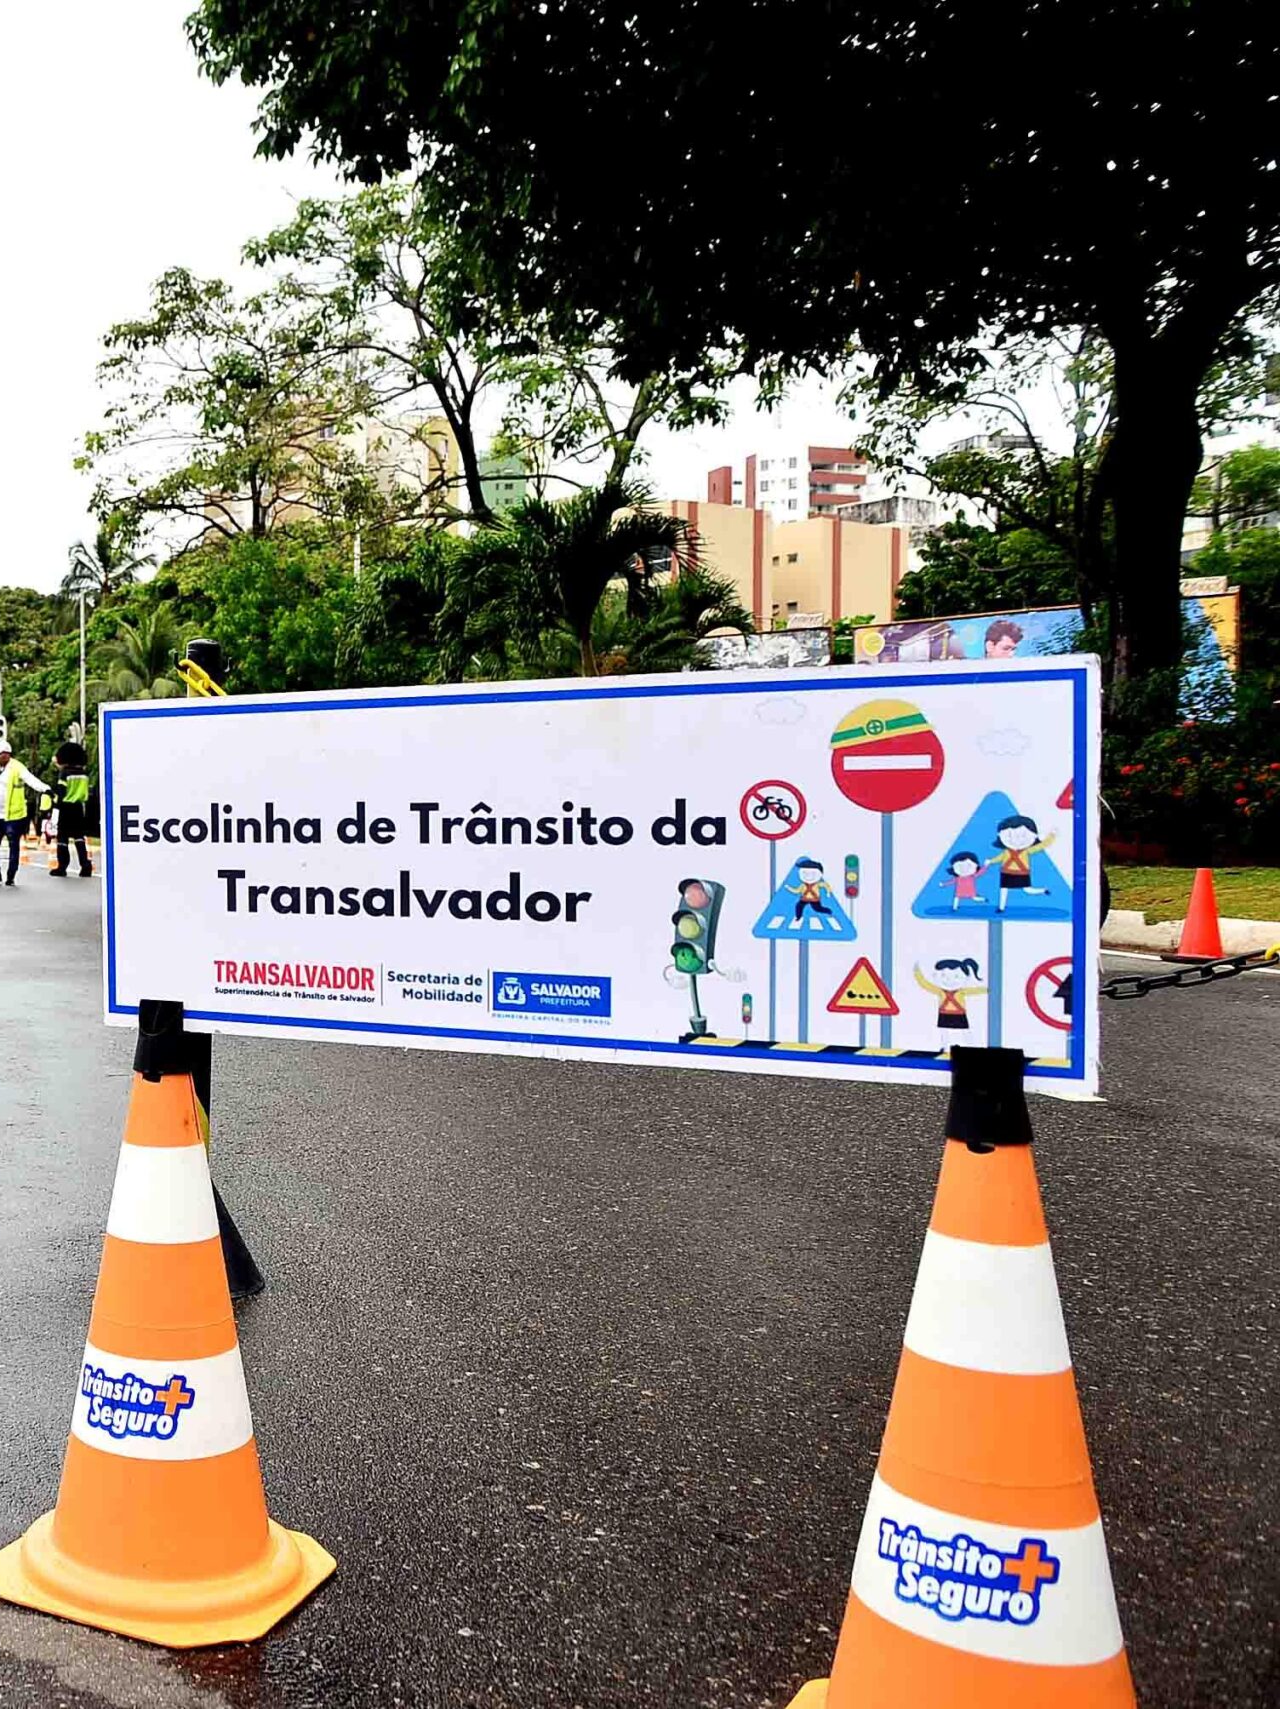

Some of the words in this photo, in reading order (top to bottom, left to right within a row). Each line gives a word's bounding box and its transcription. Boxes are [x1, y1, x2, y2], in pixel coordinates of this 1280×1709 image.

[119, 802, 322, 844] Escolinha
[337, 801, 396, 845] de
[410, 800, 634, 846] Trânsito
[651, 798, 727, 846] da
[217, 869, 593, 922] Transalvador
[214, 960, 375, 992] TRANSALVADOR
[387, 971, 460, 986] Secretaria
[466, 974, 483, 987] de
[530, 982, 601, 1000] SALVADOR
[214, 987, 280, 998] Superintendência
[282, 990, 292, 998] de
[295, 991, 325, 1001] Trânsito
[328, 994, 338, 1002] de
[340, 994, 375, 1004] Salvador
[402, 988, 483, 1004] Mobilidade
[540, 997, 591, 1008] PREFEITURA
[82, 1367, 155, 1406] Trânsito
[90, 1395, 174, 1437] Seguro
[879, 1521, 1003, 1580] Trânsito
[898, 1563, 1034, 1622] Seguro
